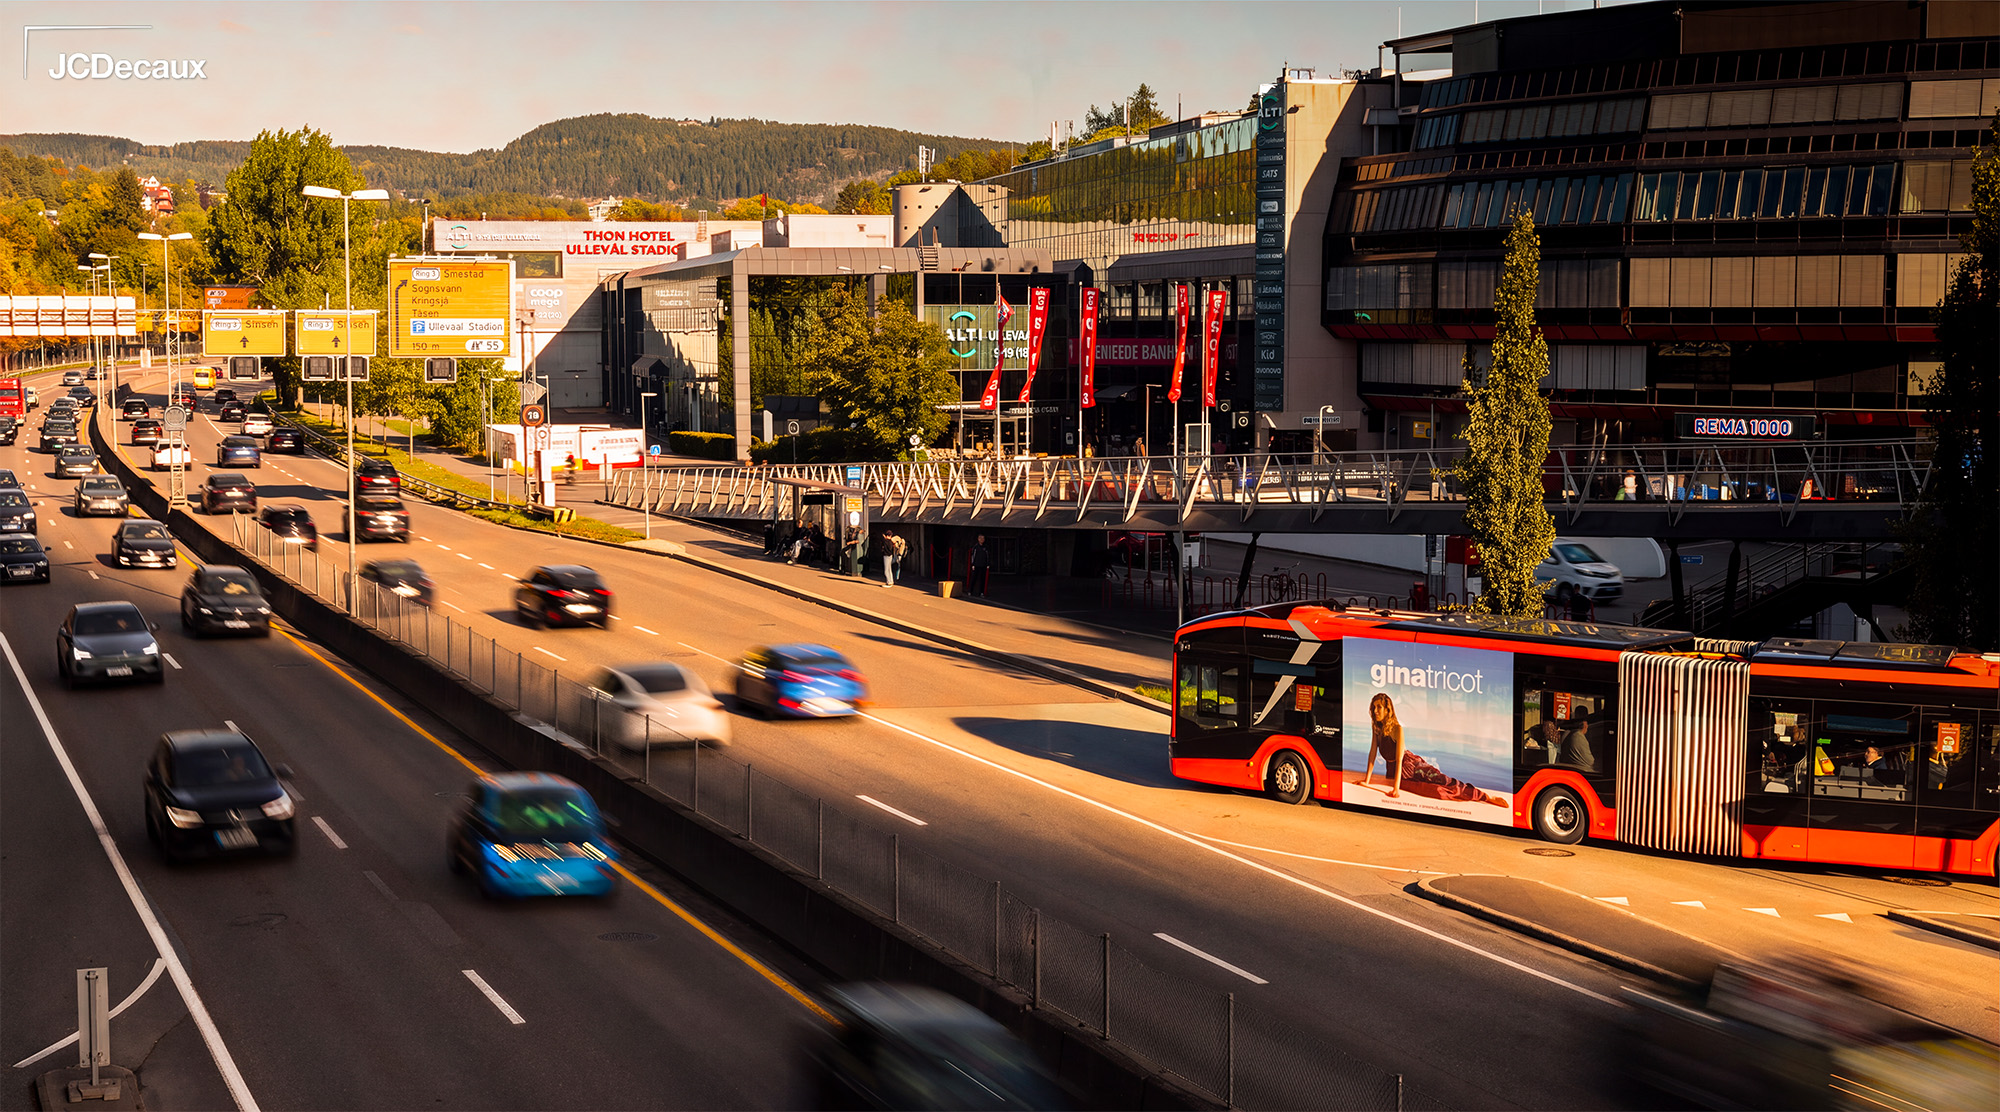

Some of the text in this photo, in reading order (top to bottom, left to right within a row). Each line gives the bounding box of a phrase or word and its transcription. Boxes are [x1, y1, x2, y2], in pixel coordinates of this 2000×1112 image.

[1257, 107, 1282, 118] ALTI
[1262, 169, 1278, 179] SATS
[446, 233, 472, 241] ALTI
[583, 230, 675, 242] THON HOTEL
[566, 243, 680, 255] ULLEVÅL STADIO
[415, 270, 430, 278] Ring
[444, 269, 484, 278] Smestad
[411, 284, 462, 294] Sognsvann
[530, 289, 563, 299] coop
[530, 299, 560, 308] mega
[215, 321, 231, 330] Ring
[245, 320, 279, 329] Sinsen
[307, 321, 324, 330] Ring
[337, 320, 370, 329] Sisen
[428, 322, 463, 331] Ullevaal
[468, 322, 503, 331] Stadion
[946, 328, 983, 341] ALTI
[412, 342, 427, 350] 150
[486, 341, 499, 350] 55
[1261, 349, 1275, 360] Kid
[1694, 418, 1792, 436] REMA 1000
